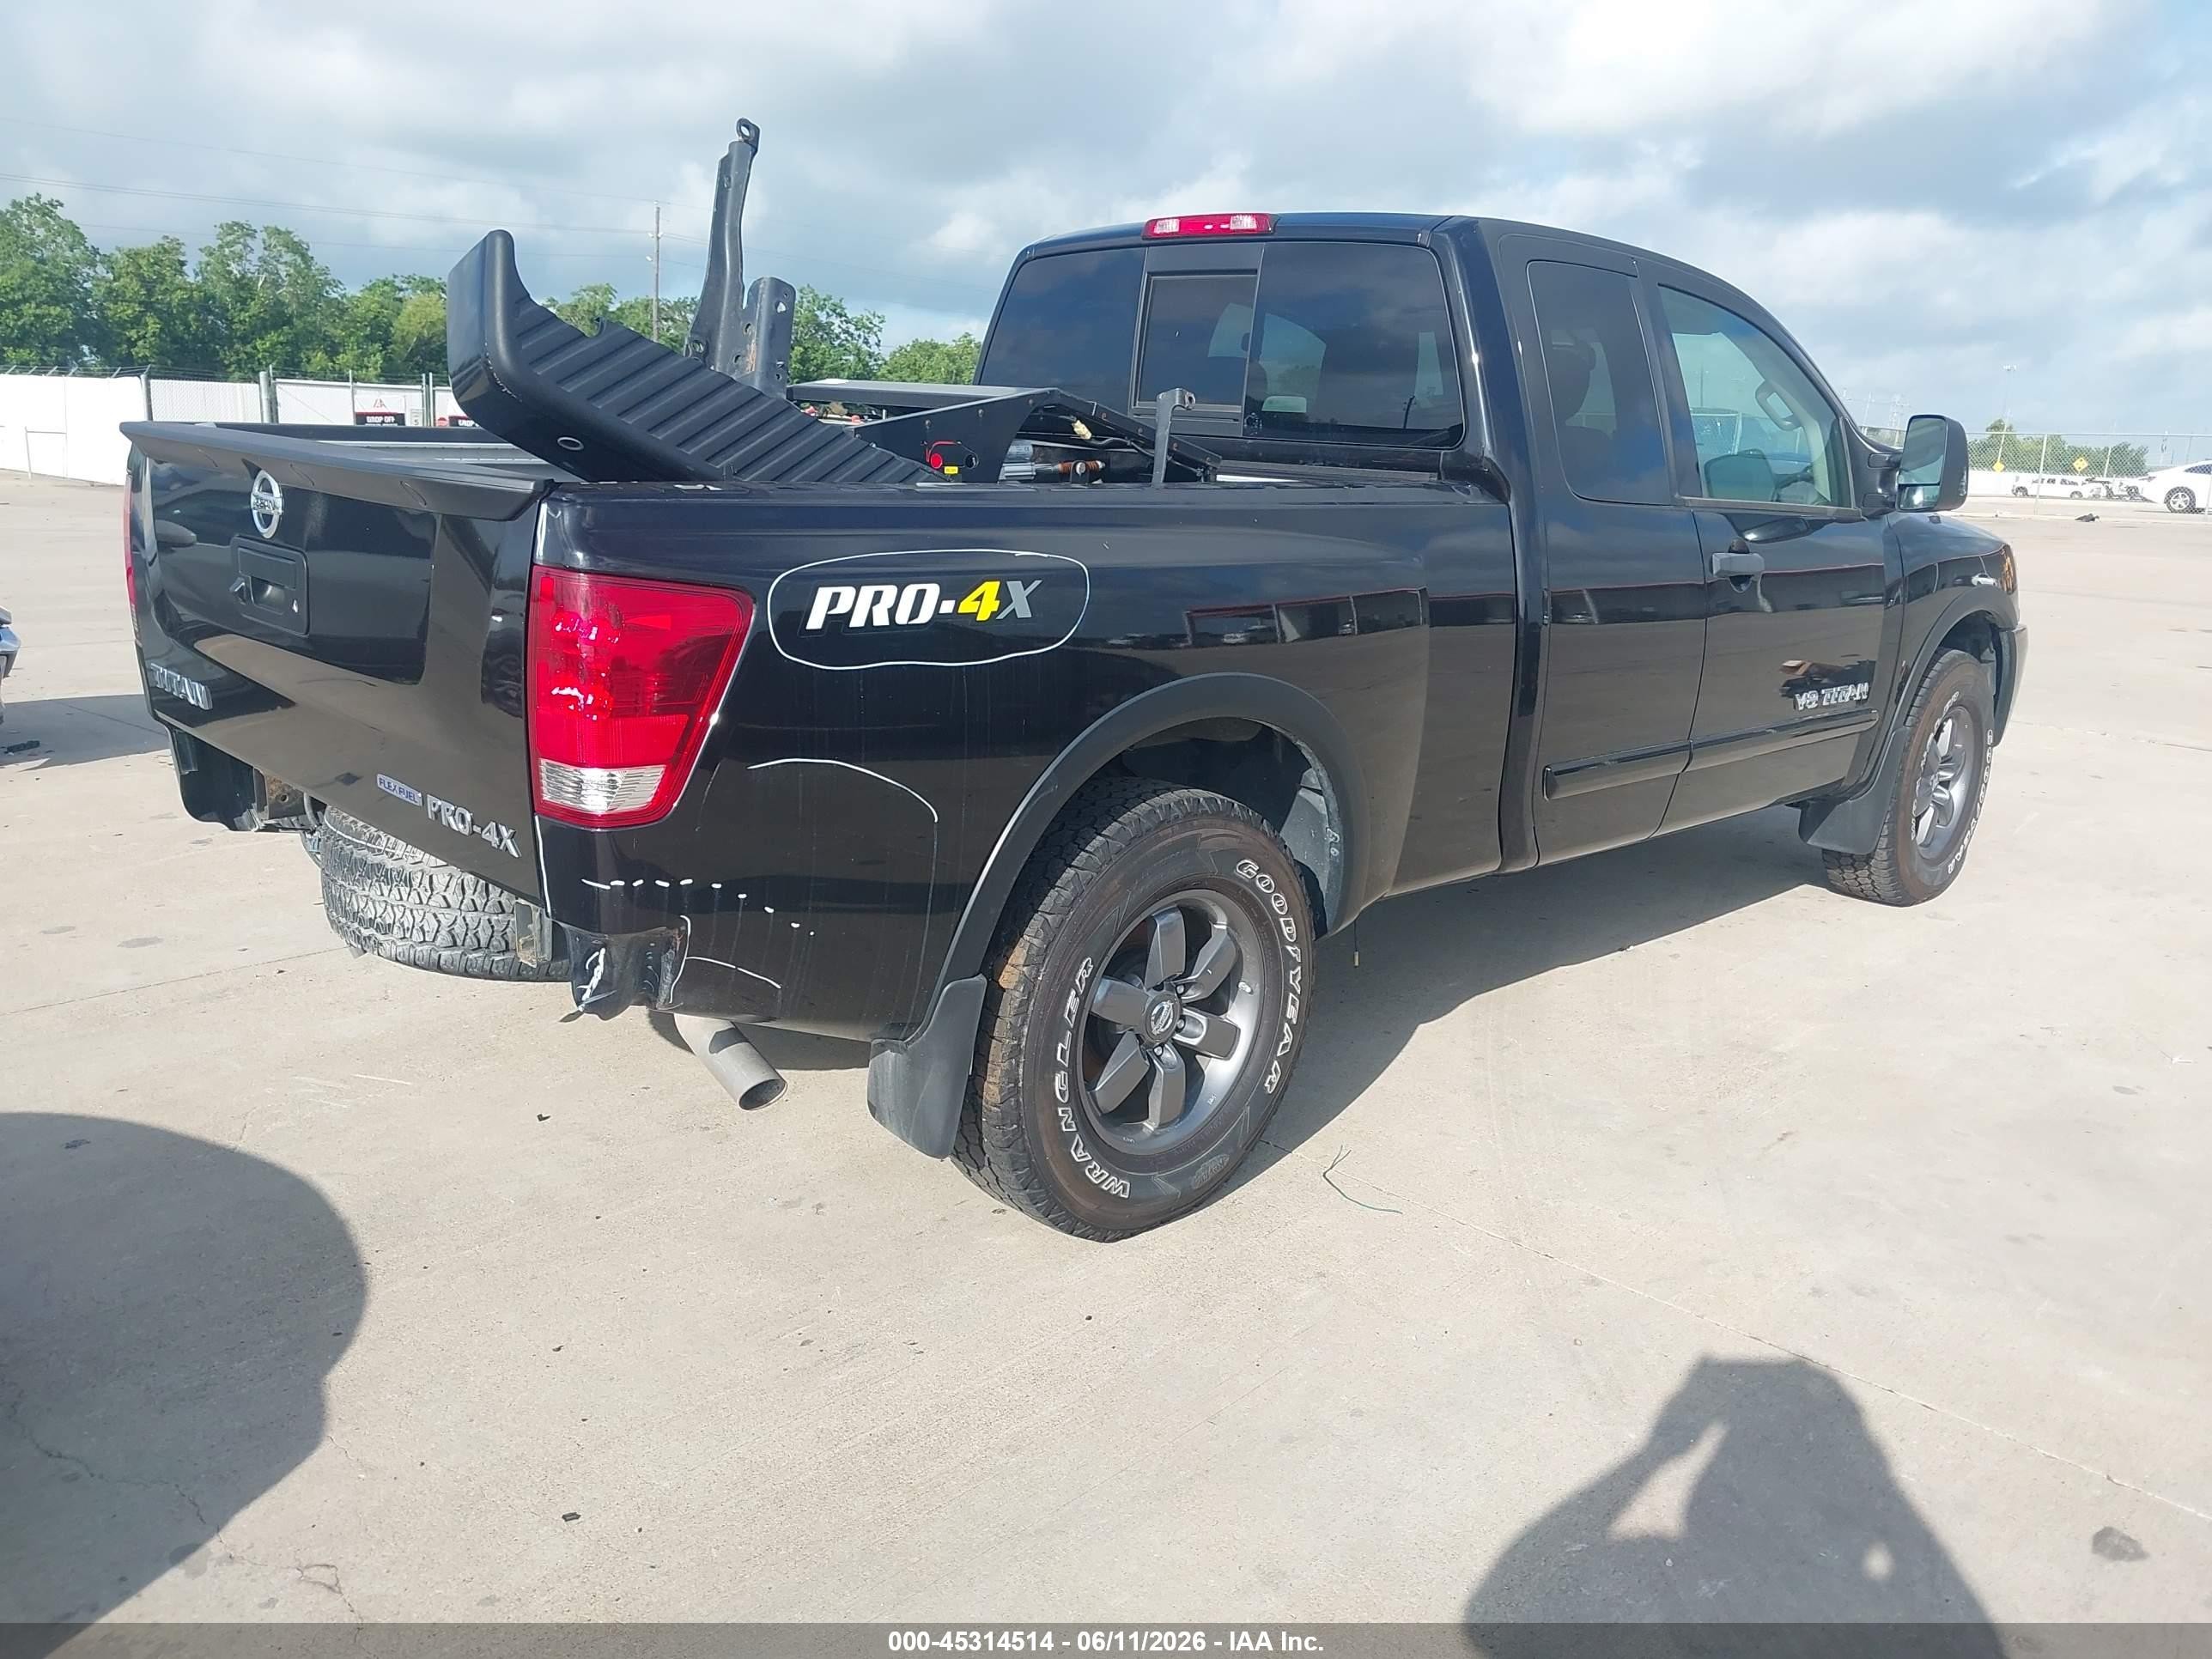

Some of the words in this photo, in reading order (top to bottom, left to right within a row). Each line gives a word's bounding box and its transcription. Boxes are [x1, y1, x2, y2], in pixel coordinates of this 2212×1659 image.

[805, 580, 1042, 630] PRO-4X
[150, 663, 213, 710] TITAN
[1795, 690, 1819, 711] V8
[1821, 682, 1869, 706] TITAN
[379, 777, 398, 793] FLEX
[398, 786, 418, 804] FUEL
[427, 793, 522, 859] PRO-4X
[1236, 859, 1302, 1094] GOODYEAR
[1054, 957, 1131, 1199] WRANGLER
